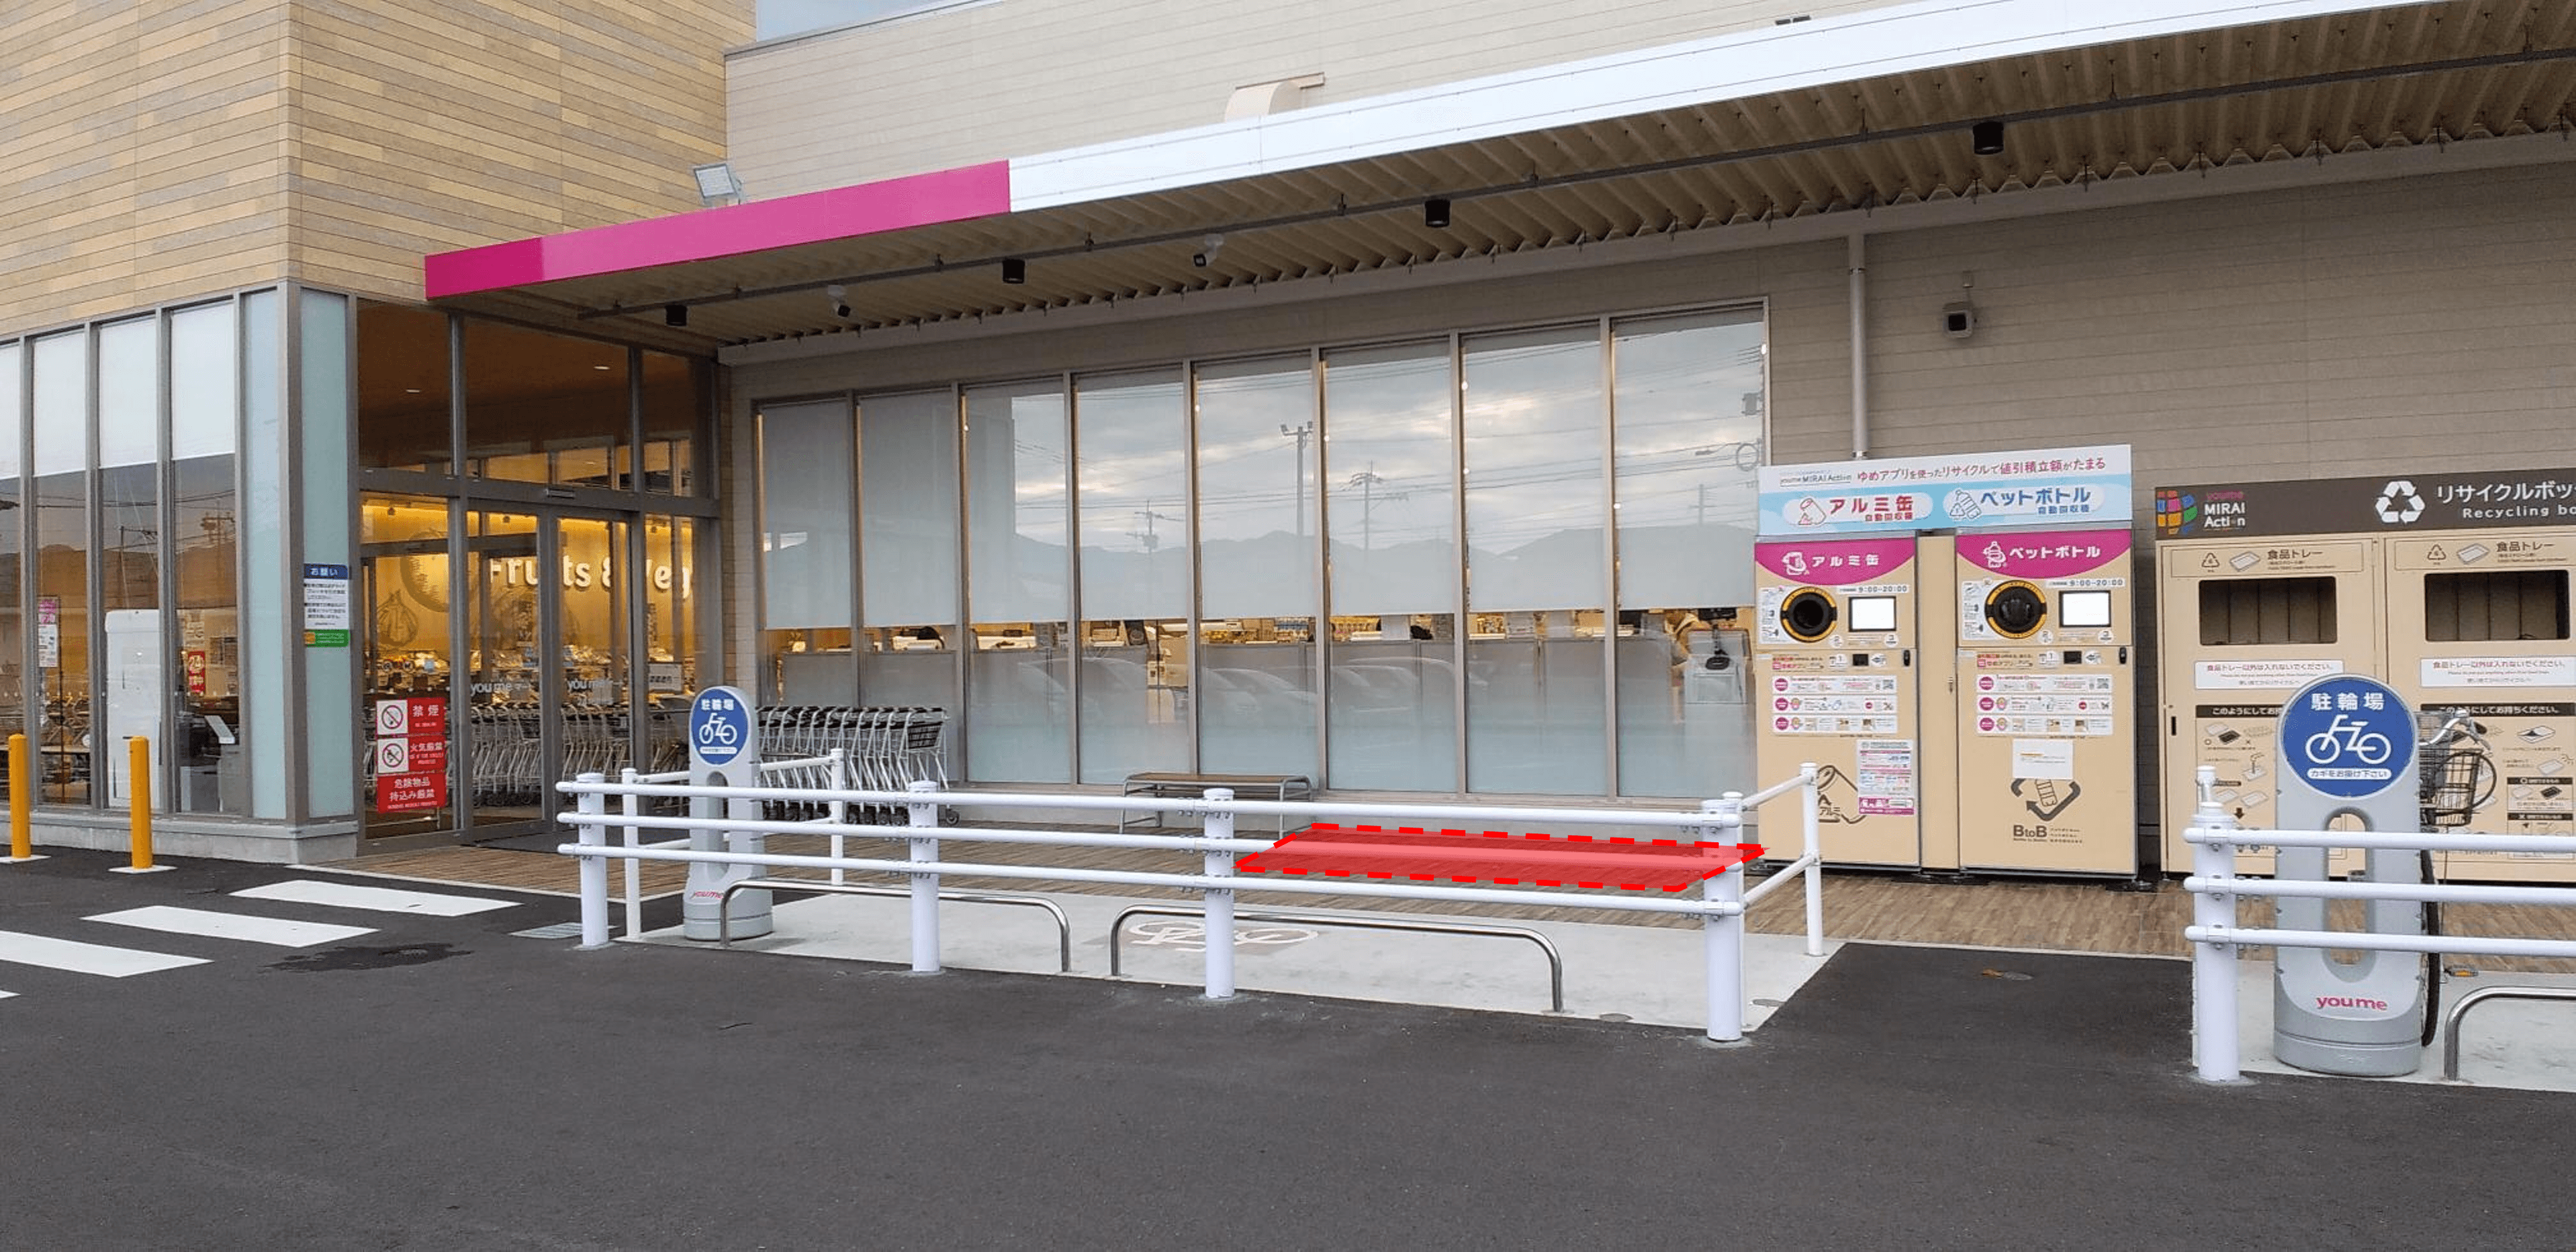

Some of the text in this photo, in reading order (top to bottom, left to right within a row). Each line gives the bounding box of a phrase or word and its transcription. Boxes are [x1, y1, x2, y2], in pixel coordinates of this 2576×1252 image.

[1981, 487, 2091, 506] ペットボトル
[2437, 480, 2576, 503] リサイクルボッ
[1830, 495, 1913, 514] アルミ缶
[2204, 502, 2245, 515] MIRAI
[2463, 506, 2549, 518] Recycling
[2009, 546, 2100, 559] ペットボトル
[2496, 541, 2555, 552] 食品トレー
[1812, 554, 1878, 567] アルミ缶
[2267, 549, 2323, 559] 食品トレー
[2311, 693, 2383, 711] 駐輪場
[413, 705, 439, 717] 禁煙
[2013, 825, 2047, 837] BtoB
